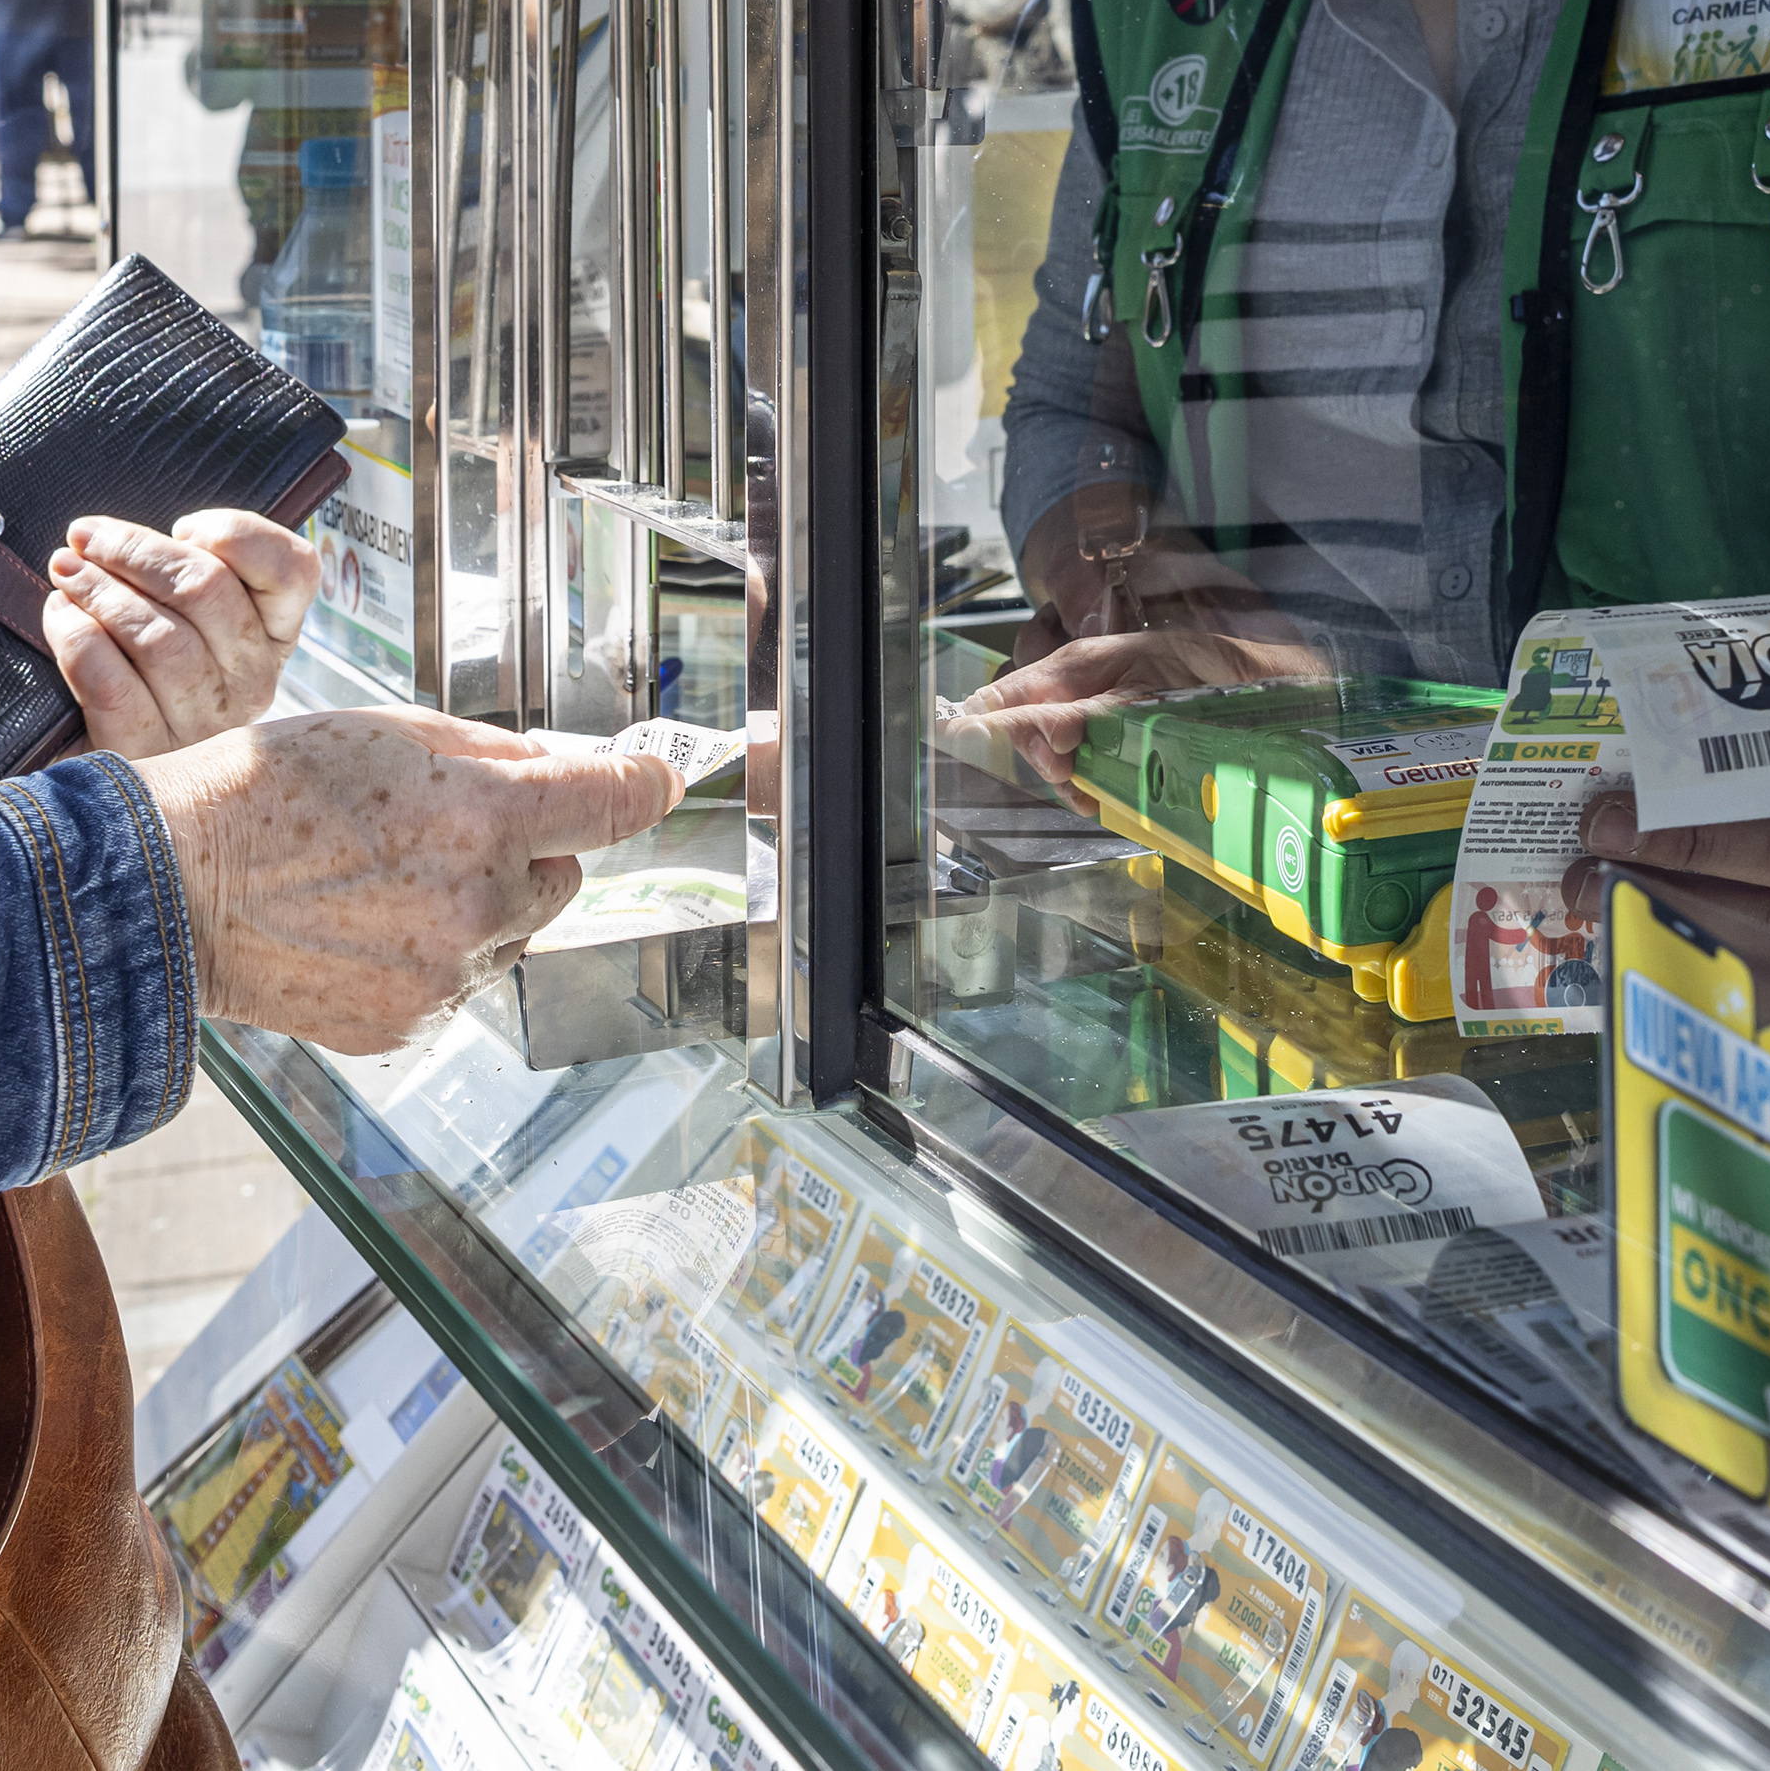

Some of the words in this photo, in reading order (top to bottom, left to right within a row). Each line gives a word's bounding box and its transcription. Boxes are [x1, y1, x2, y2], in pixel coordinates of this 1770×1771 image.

[1559, 652, 1589, 663] Enter
[1349, 744, 1399, 756] VISA
[1521, 745, 1594, 759] ONCE
[1383, 757, 1479, 786] Getnet
[1284, 852, 1296, 866] NFC
[1631, 980, 1726, 1106] NUEVA
[1238, 1110, 1403, 1151] 41475
[930, 1275, 976, 1327] 98872
[1078, 1391, 1131, 1450] 85303
[799, 1436, 840, 1489] 44967
[1048, 1494, 1084, 1531] MADRE
[1232, 1508, 1251, 1532] 046
[1251, 1526, 1307, 1594] 17404
[950, 1583, 999, 1644] 86198
[1255, 1588, 1275, 1612] MAYO
[647, 1622, 691, 1689] 36382
[1090, 1701, 1108, 1724] 067
[1426, 1689, 1443, 1708] SERIE
[1431, 1663, 1454, 1691] 071
[1452, 1683, 1530, 1761] 52545
